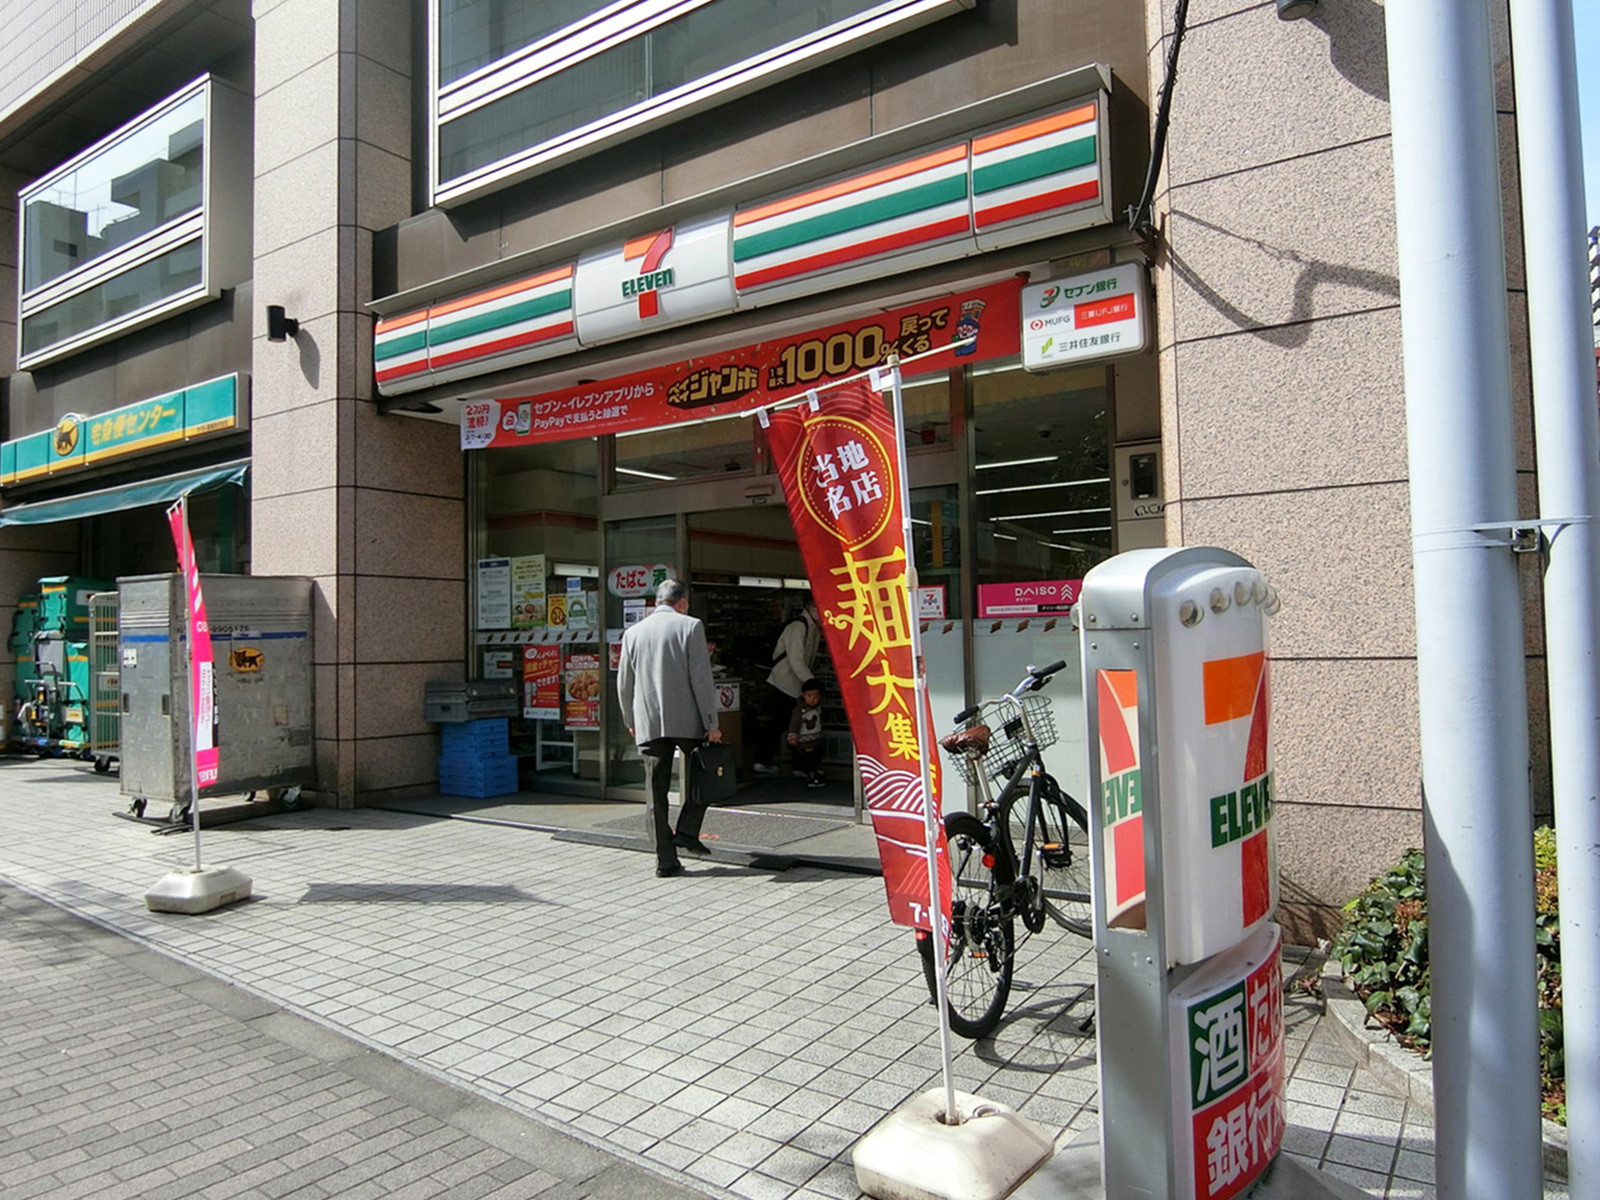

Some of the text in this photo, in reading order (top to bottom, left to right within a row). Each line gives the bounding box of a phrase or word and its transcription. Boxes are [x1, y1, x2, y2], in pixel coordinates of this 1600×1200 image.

[1064, 278, 1118, 299] セブン銀行
[1045, 315, 1070, 327] MUFG
[1081, 303, 1128, 319] 三菱UFJ銀行
[901, 309, 949, 336] 戻って
[902, 335, 930, 355] くる
[1059, 332, 1121, 353] 三井住友銀行
[690, 367, 758, 400] ジャンボ
[91, 405, 176, 446] 宅急便センター
[534, 404, 628, 430] PayPayで支払うと抽選で
[616, 570, 647, 589] たばこ
[1015, 586, 1057, 596] DAISO
[1194, 991, 1244, 1102] 酒
